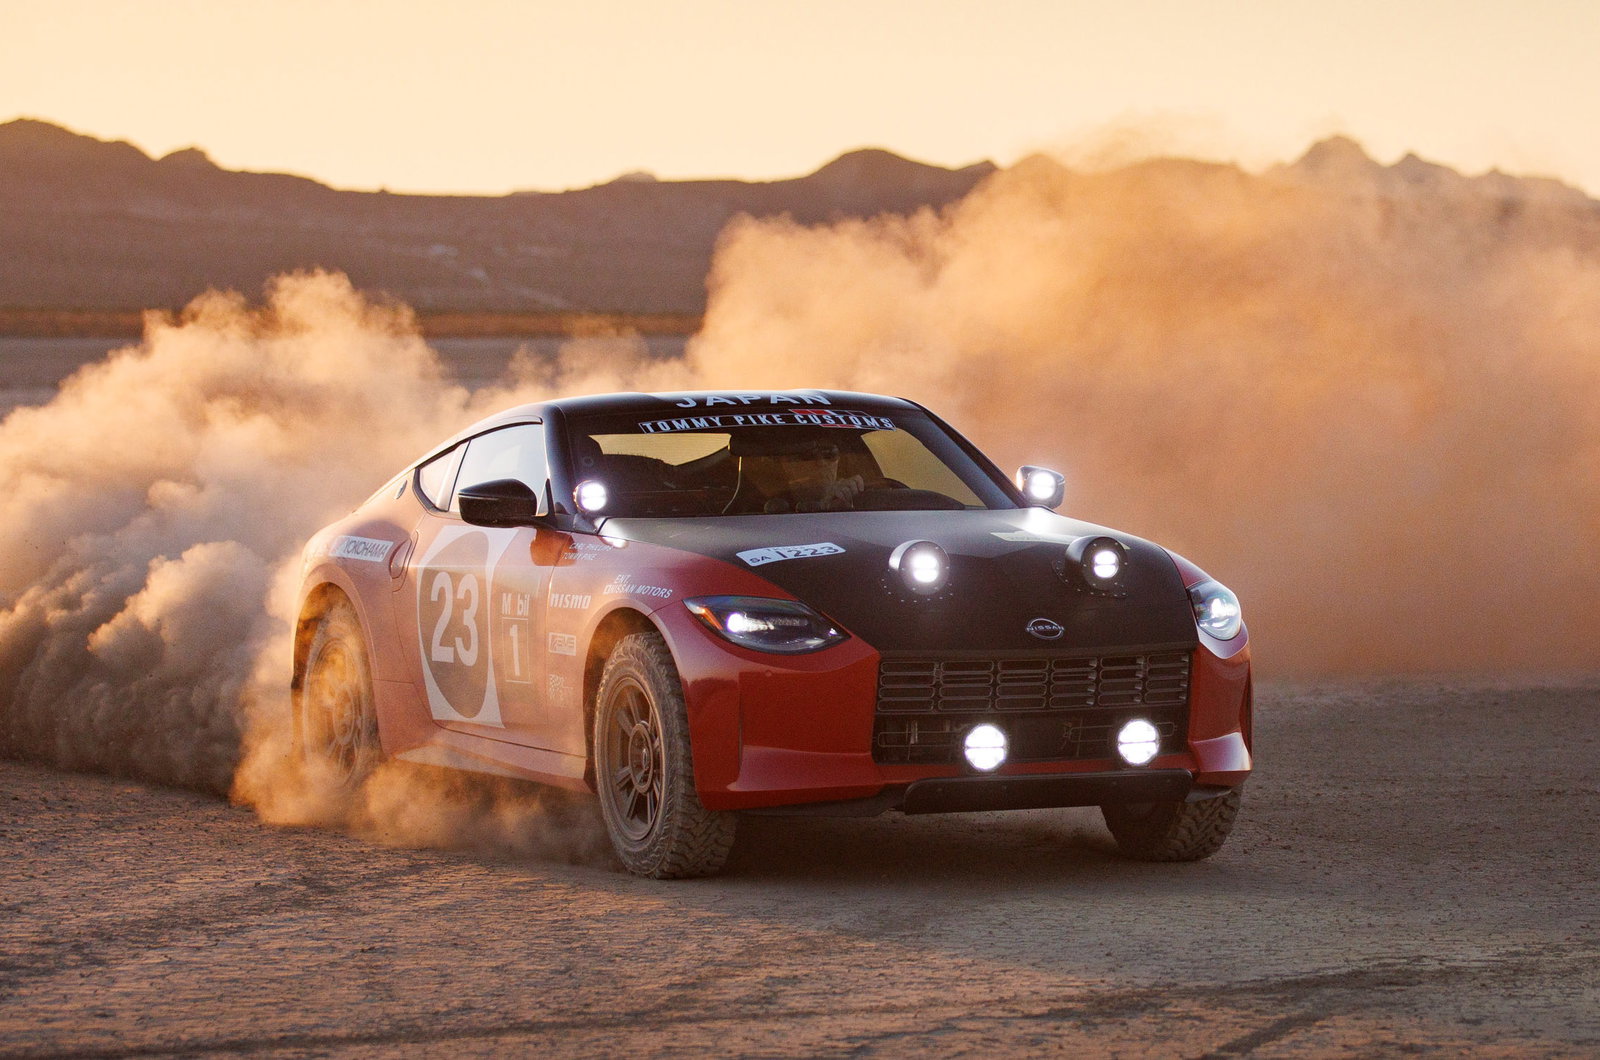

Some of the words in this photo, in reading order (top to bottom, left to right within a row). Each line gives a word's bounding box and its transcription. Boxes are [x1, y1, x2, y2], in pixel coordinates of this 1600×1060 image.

[676, 394, 832, 408] JAPAN
[642, 416, 722, 433] TOMMY
[734, 413, 786, 425] PIKE
[793, 414, 894, 428] CUSTOMS
[776, 547, 840, 558] 1223
[636, 584, 673, 599] MOTORS
[502, 592, 530, 616] Mbil
[431, 571, 479, 667] 23
[509, 624, 521, 676] 1
